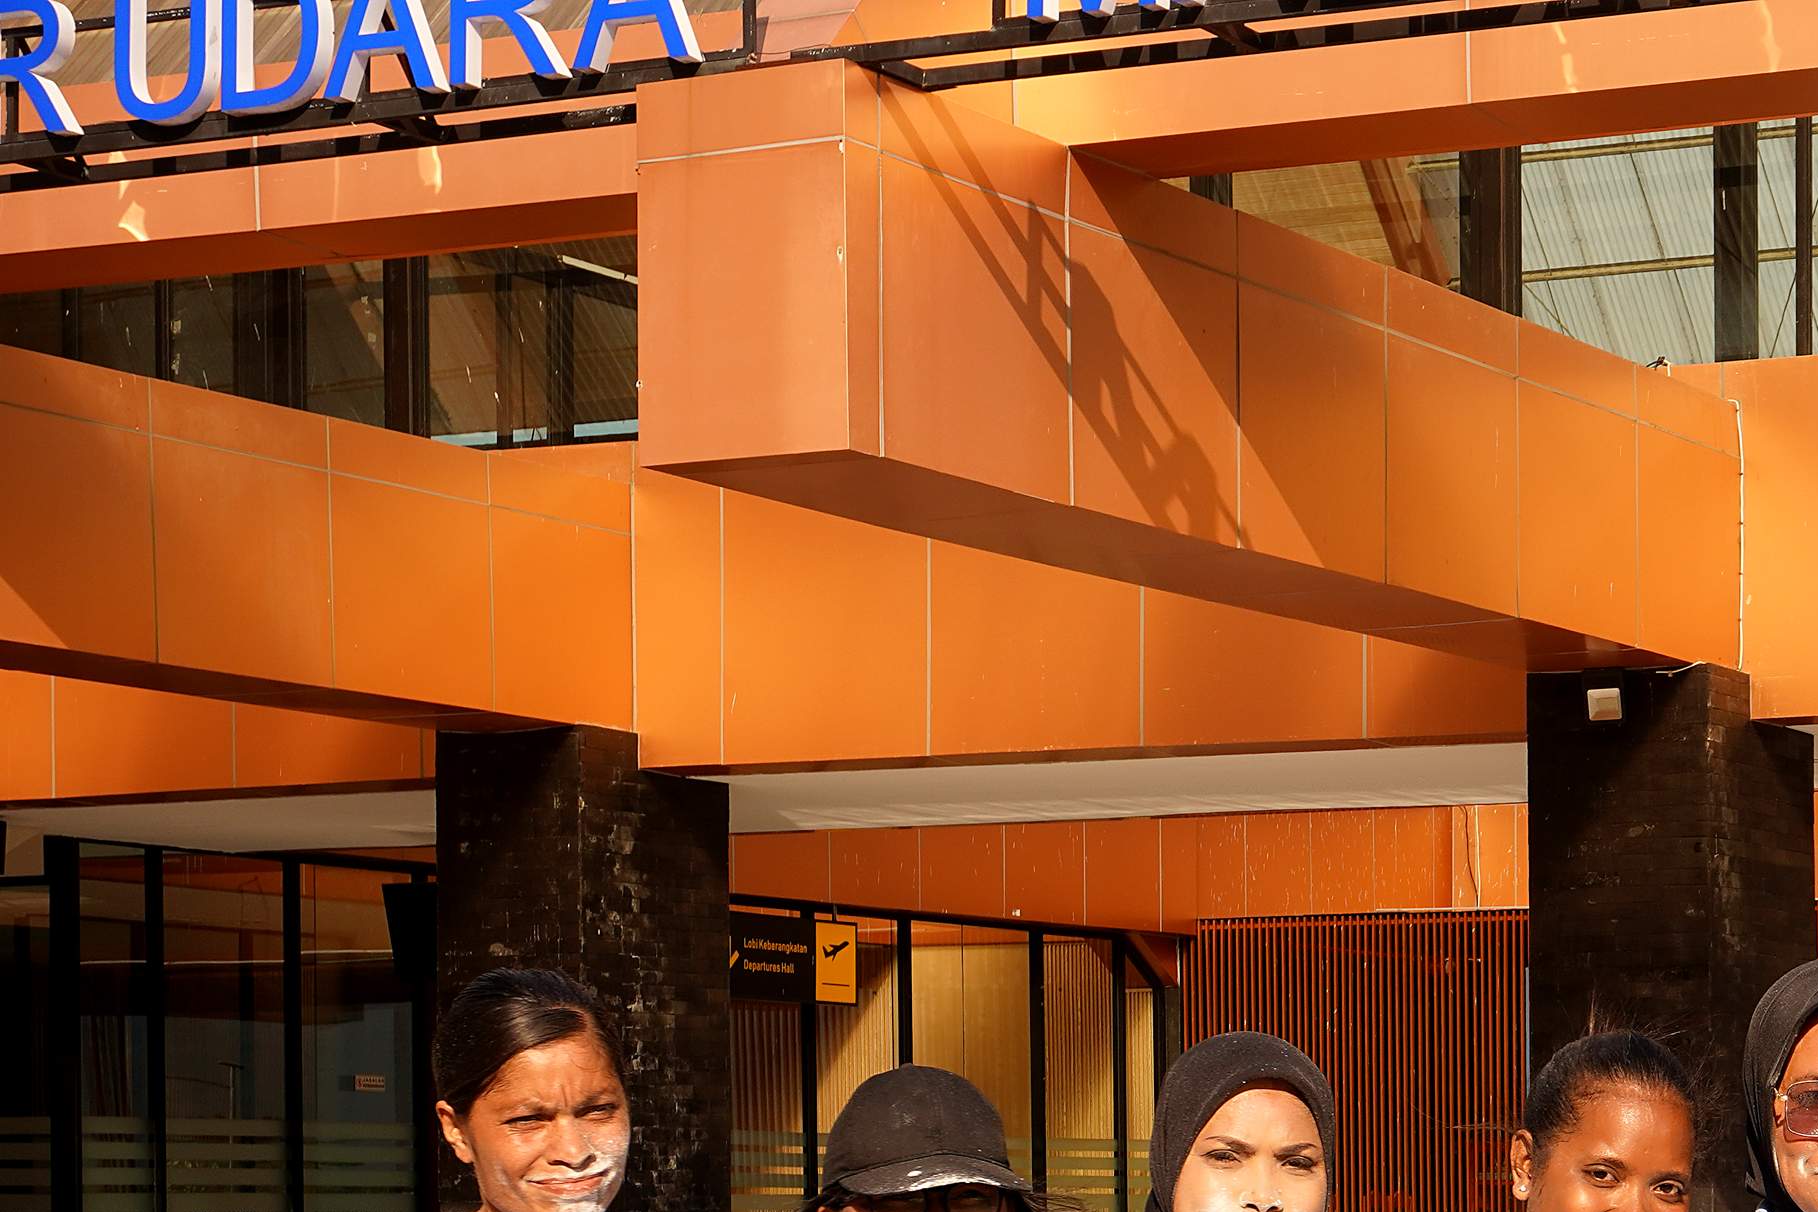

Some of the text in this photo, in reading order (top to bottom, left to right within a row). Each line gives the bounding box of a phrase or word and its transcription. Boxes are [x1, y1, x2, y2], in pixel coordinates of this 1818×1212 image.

[743, 937, 808, 955] Lobi Keberangkatan
[743, 959, 795, 974] Departures Hall
